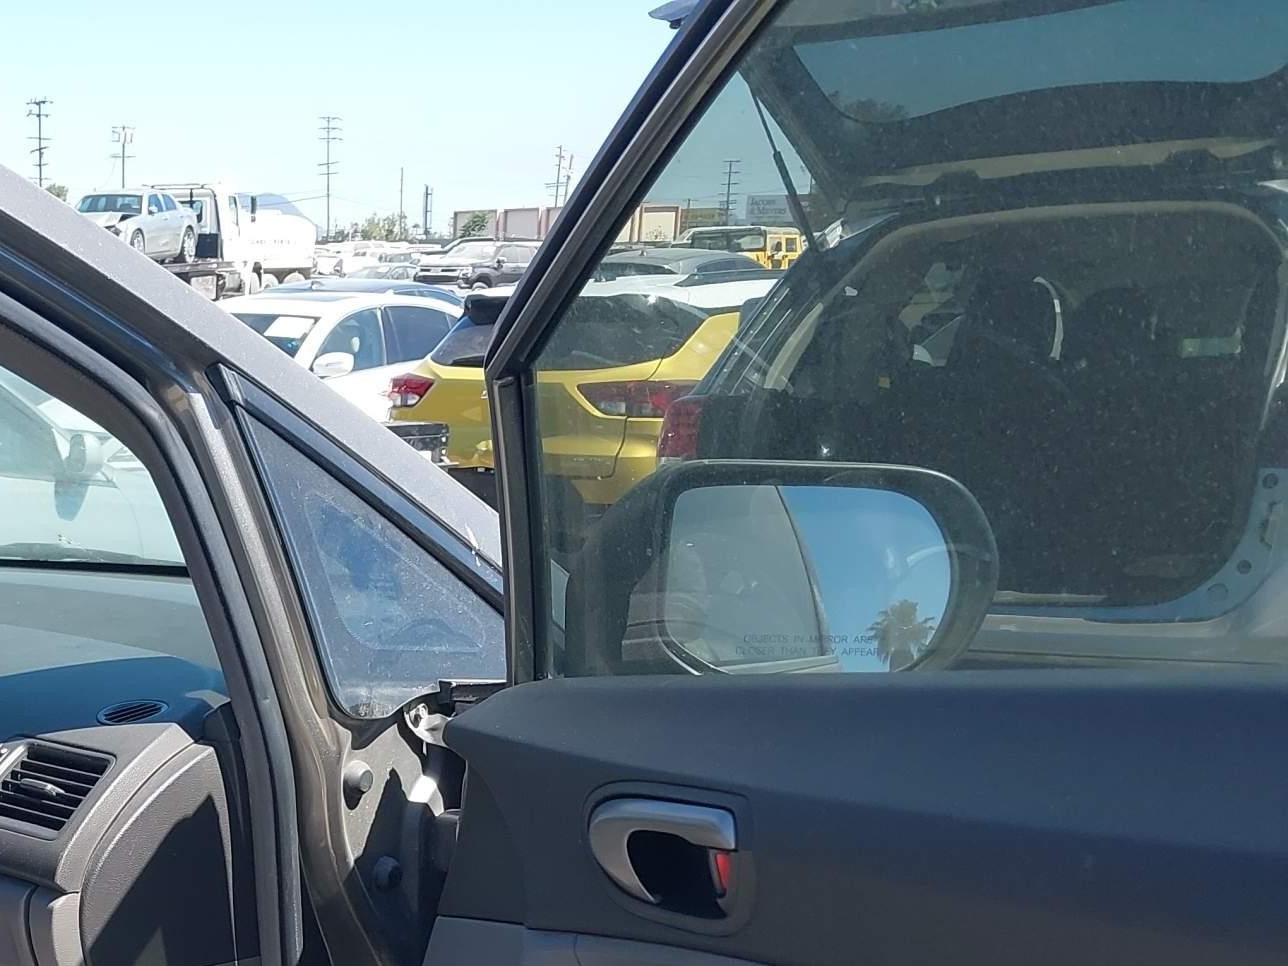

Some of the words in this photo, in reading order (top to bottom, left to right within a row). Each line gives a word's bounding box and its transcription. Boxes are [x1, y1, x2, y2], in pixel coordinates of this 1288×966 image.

[743, 633, 788, 644] OBJECTS
[793, 634, 803, 644] IN
[853, 634, 874, 645] ARE
[780, 646, 806, 656] THAN
